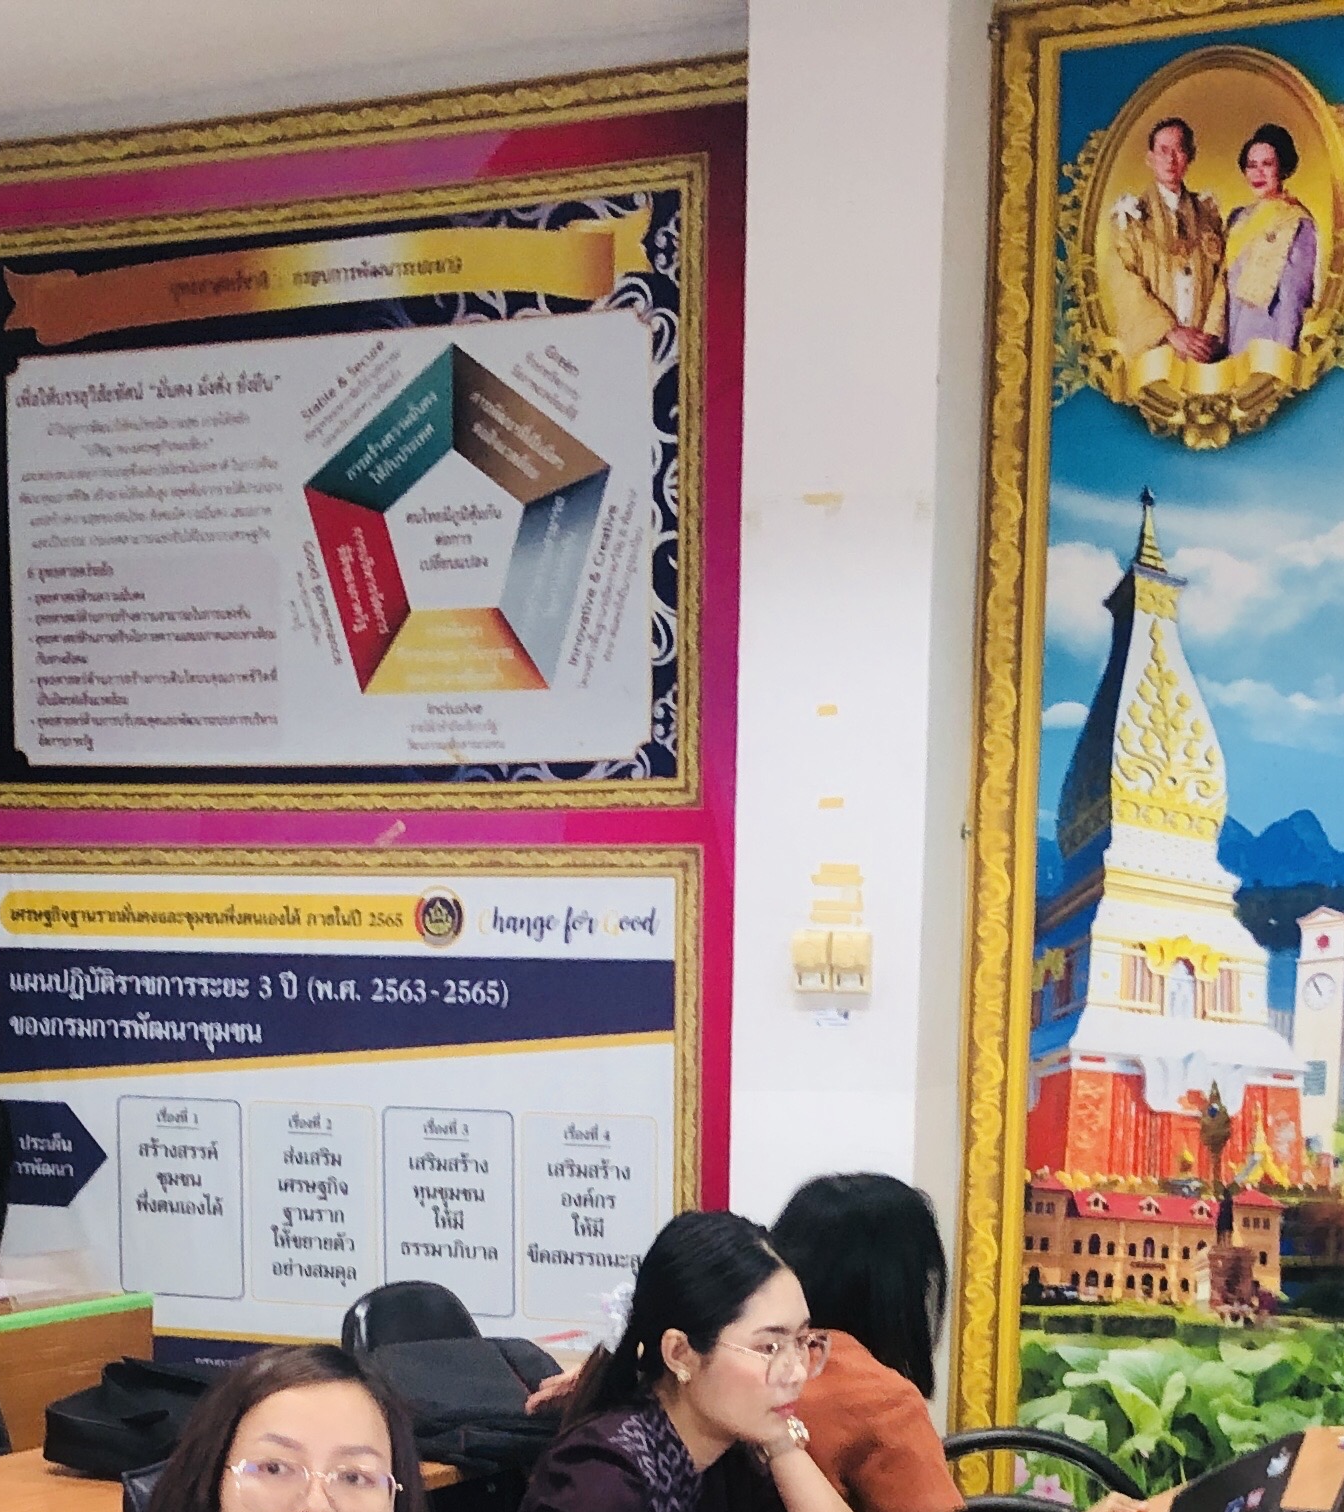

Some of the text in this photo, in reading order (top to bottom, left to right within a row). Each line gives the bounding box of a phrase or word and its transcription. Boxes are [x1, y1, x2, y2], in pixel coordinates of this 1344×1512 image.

[368, 911, 404, 929] 2565
[9, 966, 250, 1002] แผนปฏิบัติราชการระยะ
[258, 976, 273, 1001] 3
[280, 969, 298, 1002] ปี
[308, 976, 362, 1005] (พ.ศ.
[9, 1011, 263, 1055] ของกรมการพัฒนาชุมชน
[461, 1122, 469, 1136] 3
[602, 1129, 611, 1142] 4
[19, 1132, 73, 1153] ประเด็น
[138, 1136, 219, 1162] สร้างสรรค์
[13, 1158, 74, 1178] ารพัฒนา
[283, 1146, 342, 1168] ส่งเสริม
[408, 1151, 489, 1175] เสริมสร้าง
[547, 1157, 631, 1181] เสริมสร้าง
[156, 1172, 202, 1195] ชุมชน
[277, 1175, 349, 1202] เศรษฐกิจ
[135, 1192, 224, 1217] พึ่งตนเองได้
[413, 1184, 486, 1208] ทุนชุมชน
[560, 1186, 617, 1210] องค์กร
[282, 1206, 345, 1228] ฐานราก
[431, 1205, 465, 1231] ให้มี
[570, 1212, 605, 1239] ให้มี
[269, 1224, 356, 1252] ให้ขยายตัว
[400, 1239, 499, 1262] ธรรมาภิบาล
[526, 1243, 644, 1279] ขีดสมรรถนะสู
[271, 1259, 358, 1288] อย่างสมดุล
